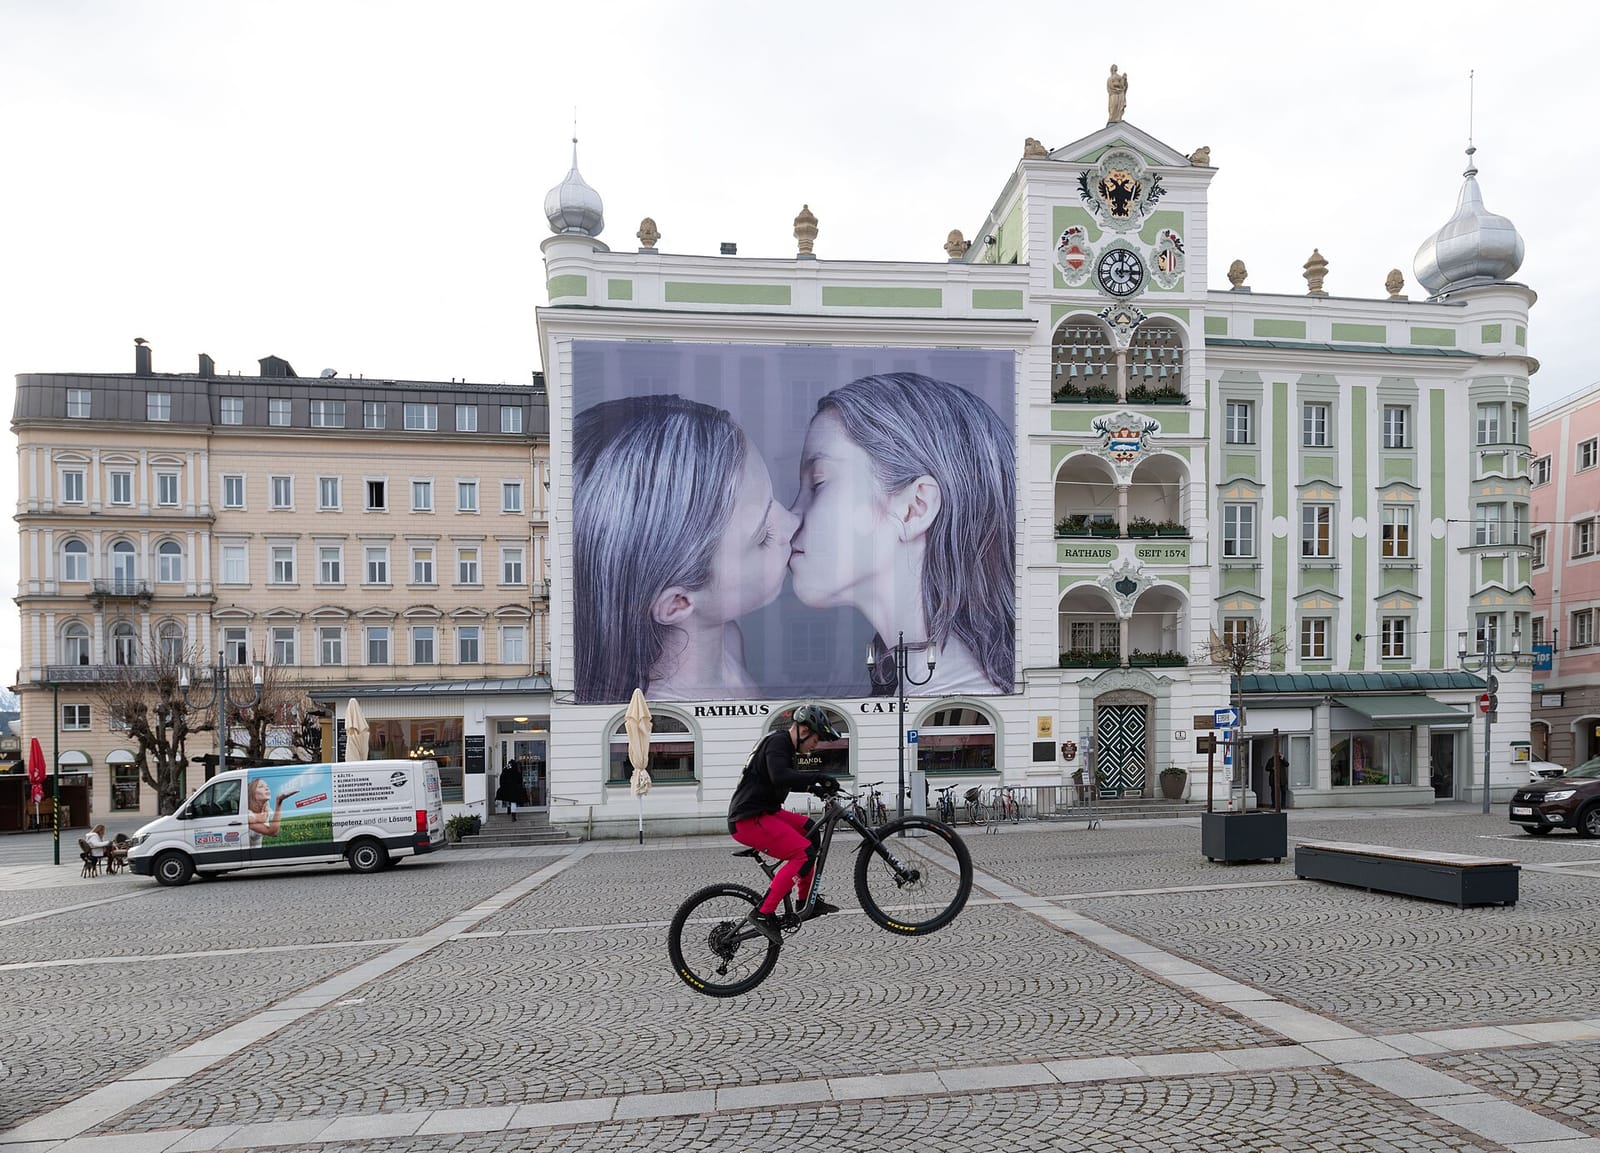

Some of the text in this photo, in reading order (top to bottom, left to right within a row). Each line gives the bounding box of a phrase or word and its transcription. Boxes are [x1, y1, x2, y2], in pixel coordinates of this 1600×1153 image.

[1065, 549, 1186, 558] RATHAUS SEIT 1574
[694, 698, 910, 717] RATHAUS CAFÉ
[326, 819, 362, 828] Kompetenz
[363, 817, 377, 825] und
[377, 816, 388, 824] die
[388, 815, 412, 823] Lösung
